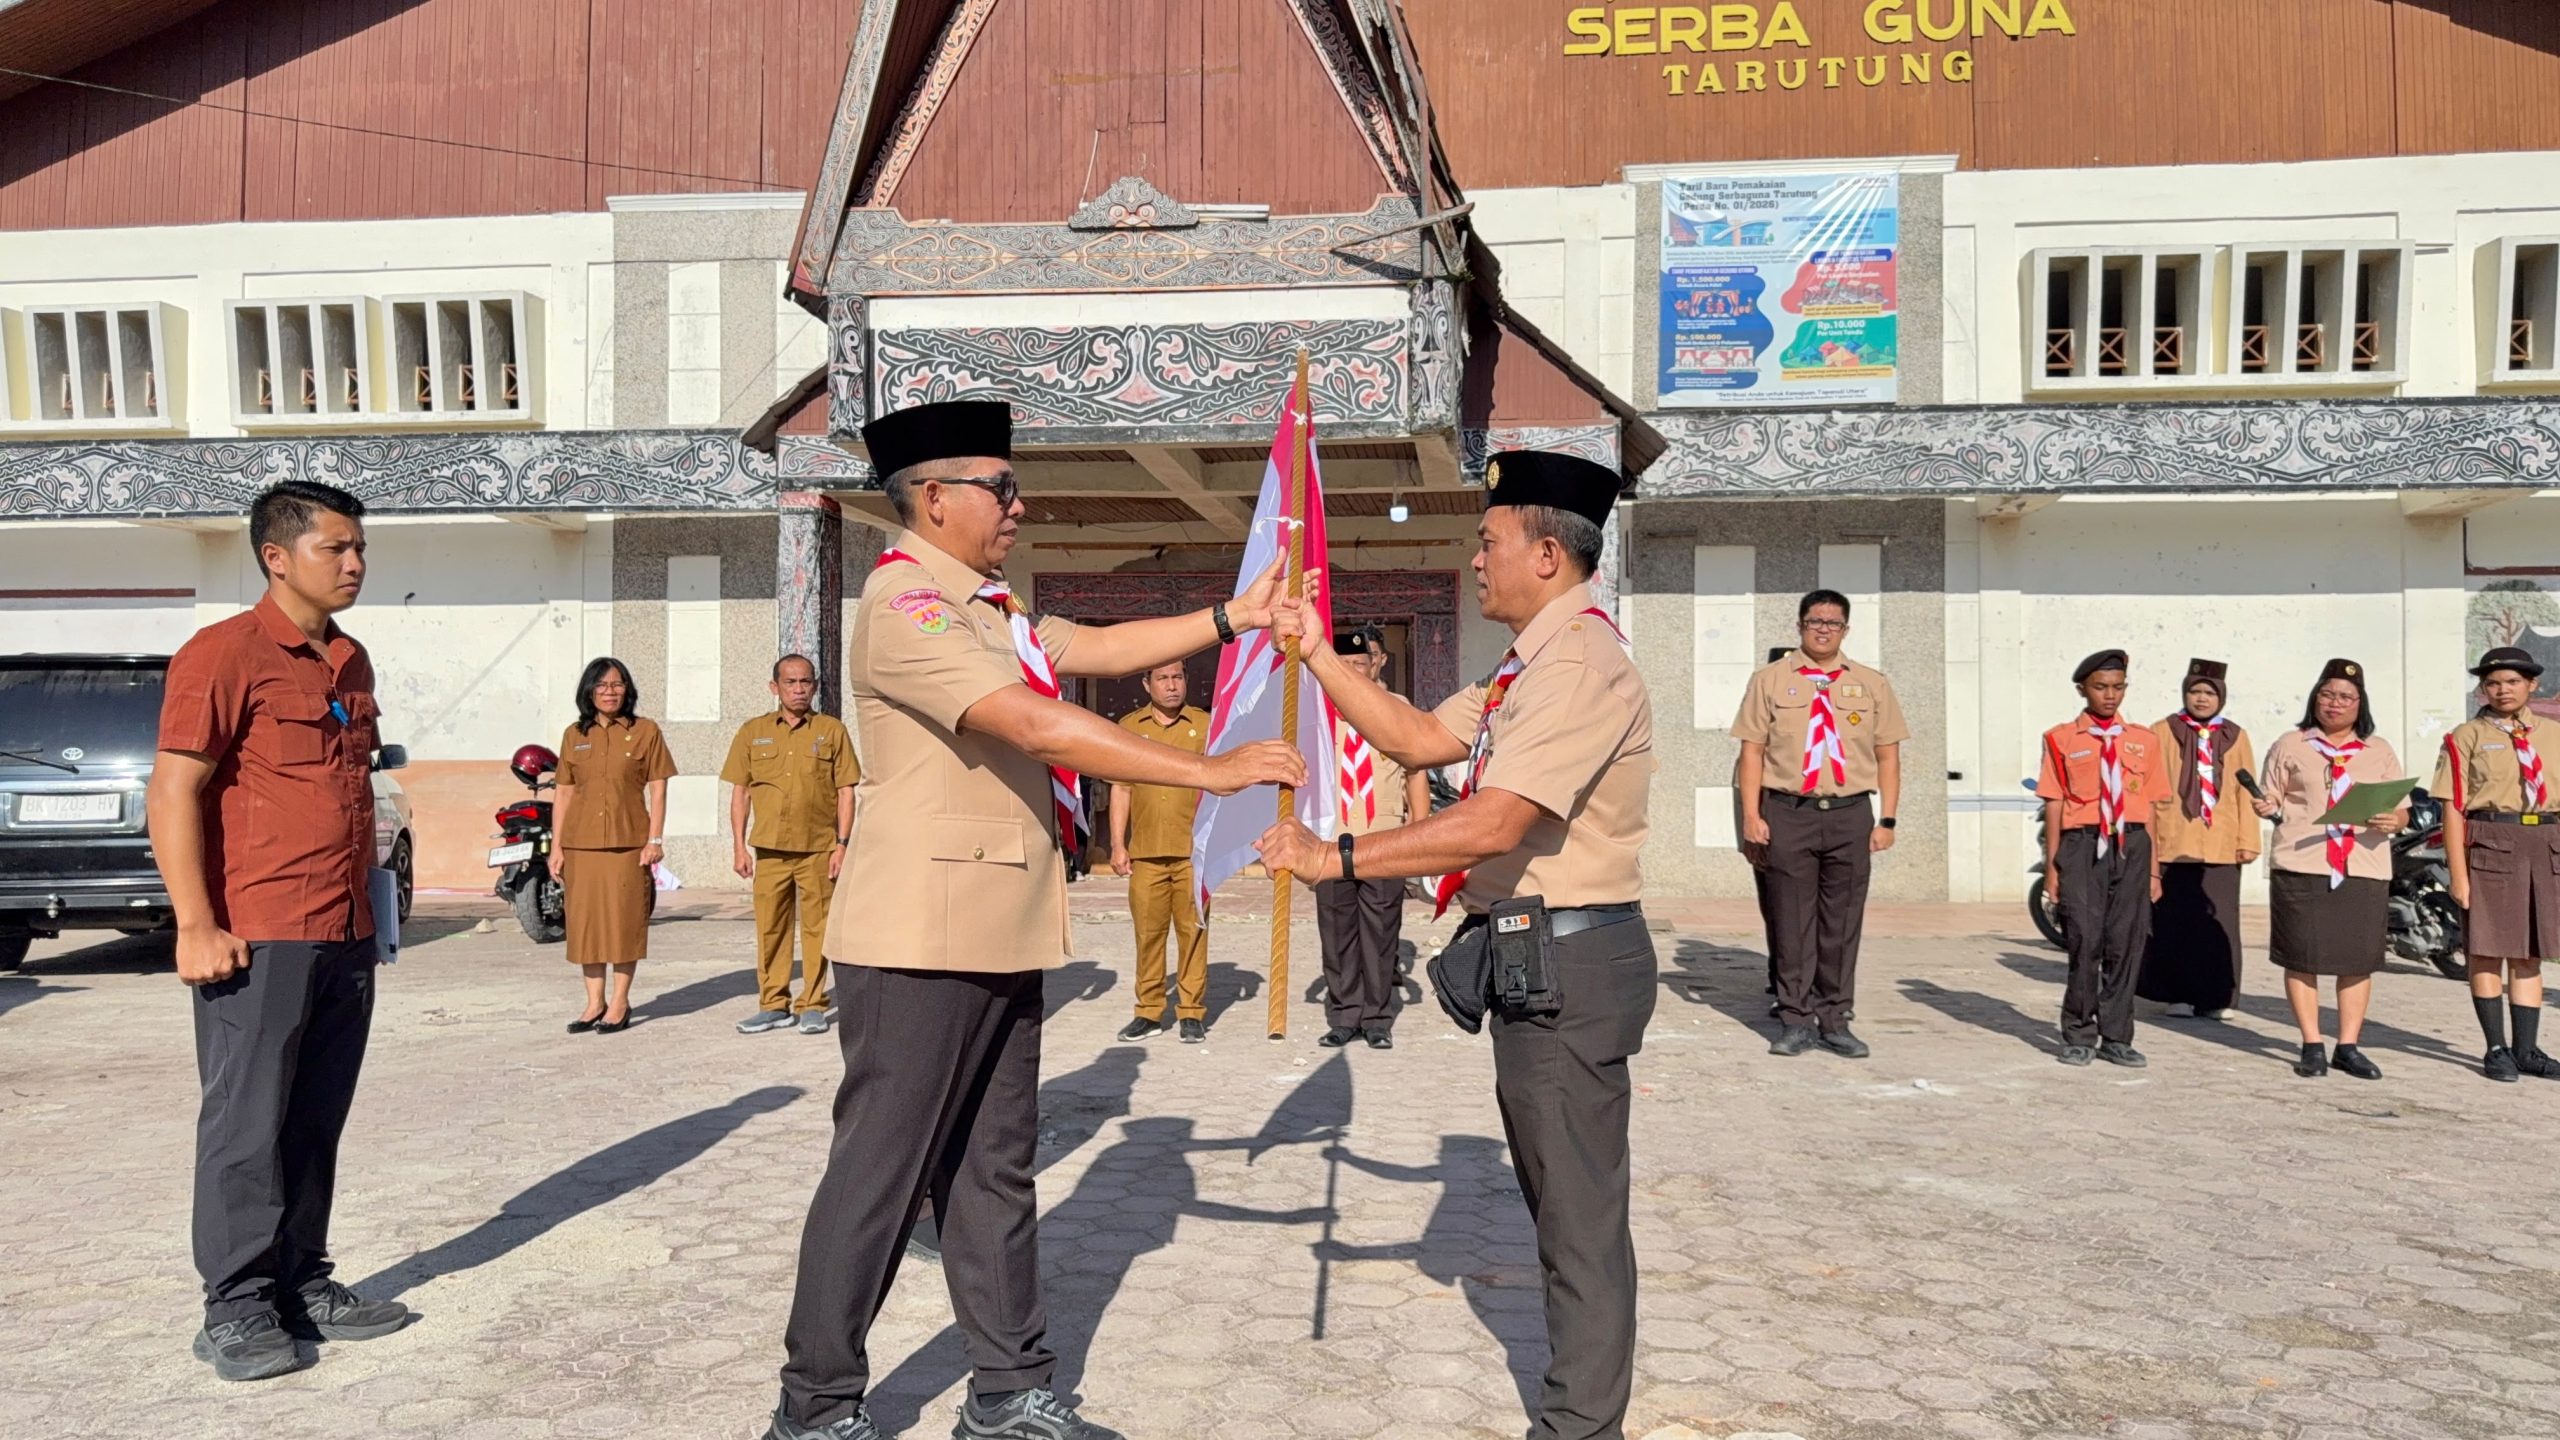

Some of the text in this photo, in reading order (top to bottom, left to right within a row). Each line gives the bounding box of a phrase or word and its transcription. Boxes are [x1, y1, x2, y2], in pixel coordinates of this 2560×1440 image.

[1563, 0, 2076, 55] SERBA GUNA
[1662, 50, 1973, 95] TARUTUNG
[1706, 181, 1729, 190] Baru
[1731, 180, 1786, 190] Pemakaian
[1718, 191, 1770, 202] Serbaguna
[1773, 189, 1818, 199] Tarutung
[1714, 201, 1730, 210] No.
[1817, 319, 1866, 330] Rp.10.000
[26, 795, 116, 813] BK 1203 HV
